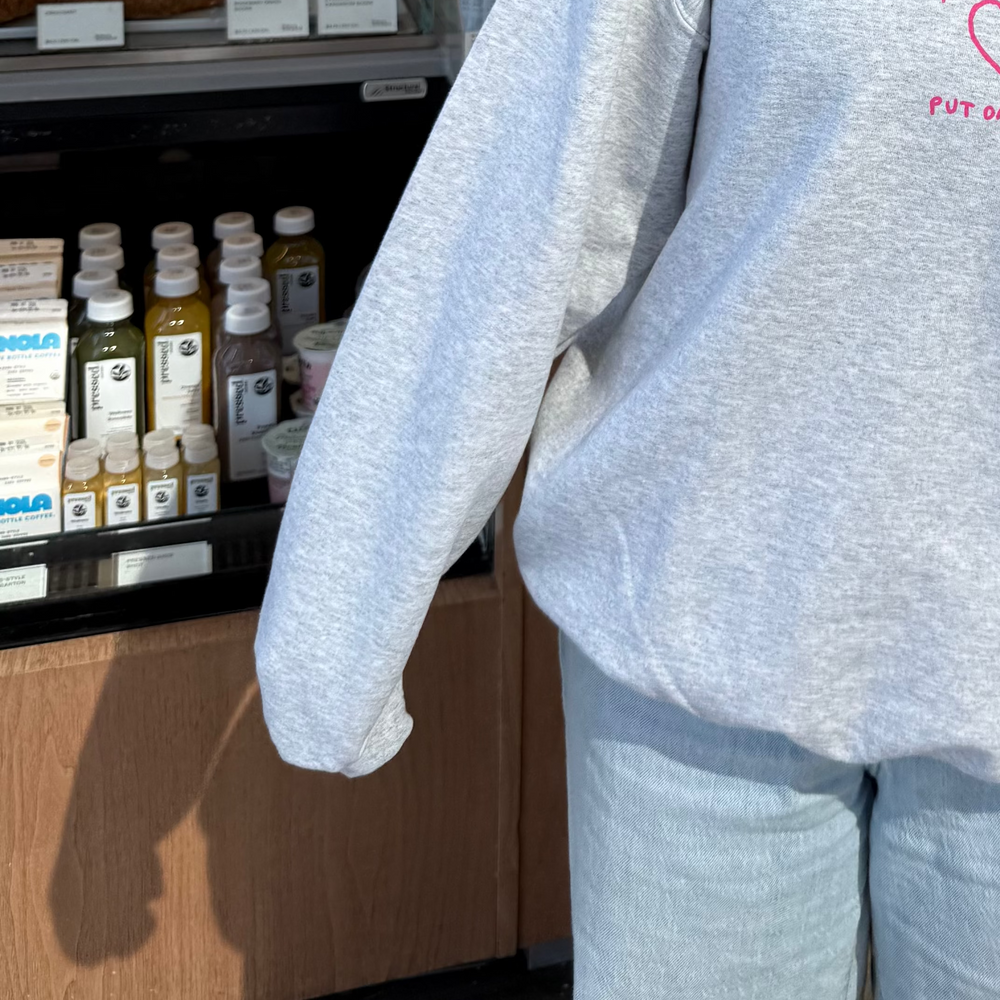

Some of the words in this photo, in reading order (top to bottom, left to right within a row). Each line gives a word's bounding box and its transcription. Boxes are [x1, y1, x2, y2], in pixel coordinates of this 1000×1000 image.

[929, 96, 976, 118] PUT
[0, 332, 61, 353] NOLA
[7, 353, 33, 361] BOTTLE
[157, 340, 172, 385] pressed
[88, 365, 103, 411] pressed
[0, 517, 23, 525] OTTLE
